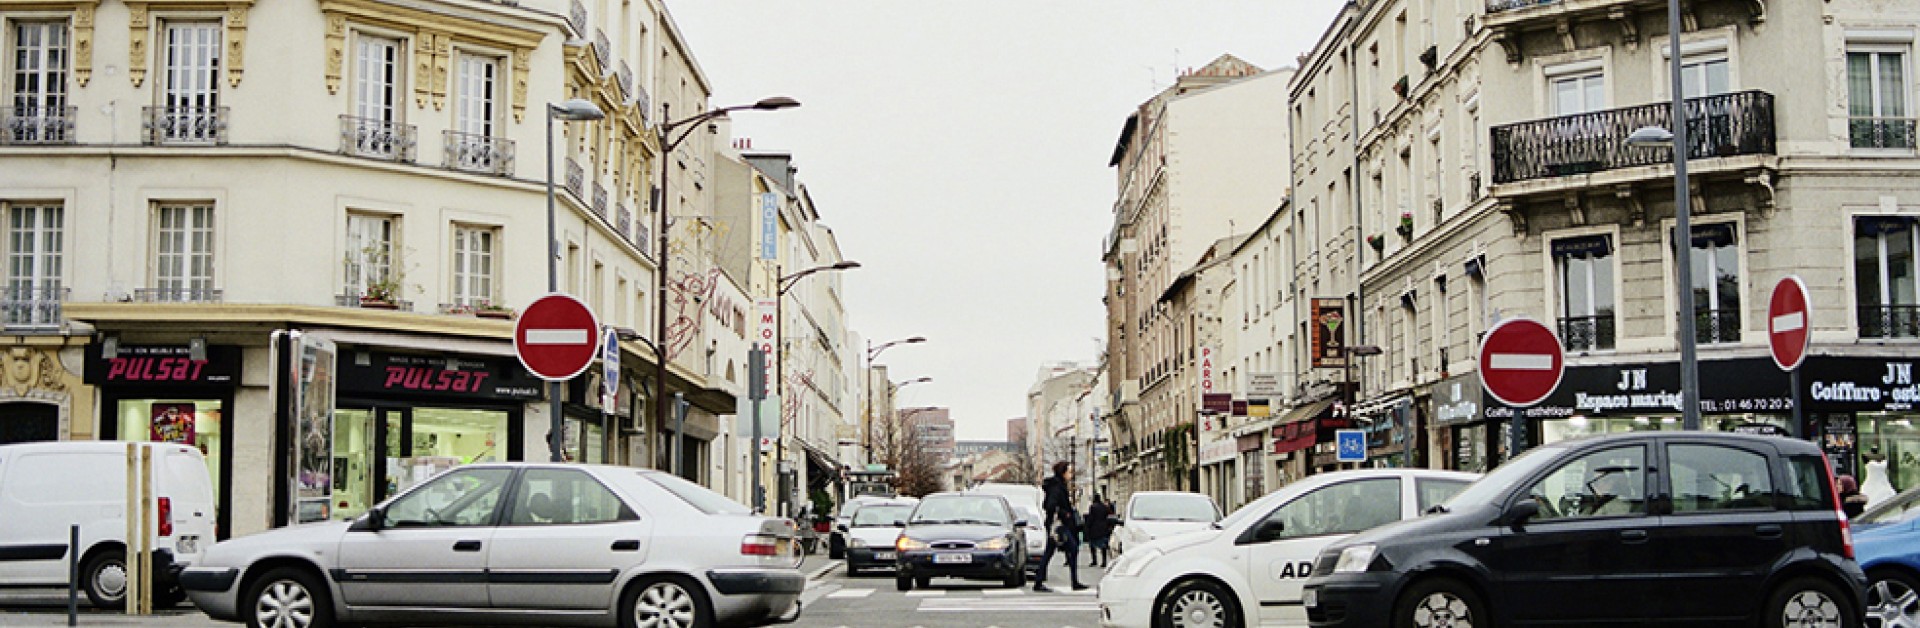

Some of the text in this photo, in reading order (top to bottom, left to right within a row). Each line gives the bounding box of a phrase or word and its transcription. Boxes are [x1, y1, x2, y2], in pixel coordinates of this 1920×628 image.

[1617, 368, 1647, 391] JN
[1882, 362, 1912, 385] JN
[1575, 389, 1682, 413] Espace mariag
[1811, 381, 1881, 402] Coiffure
